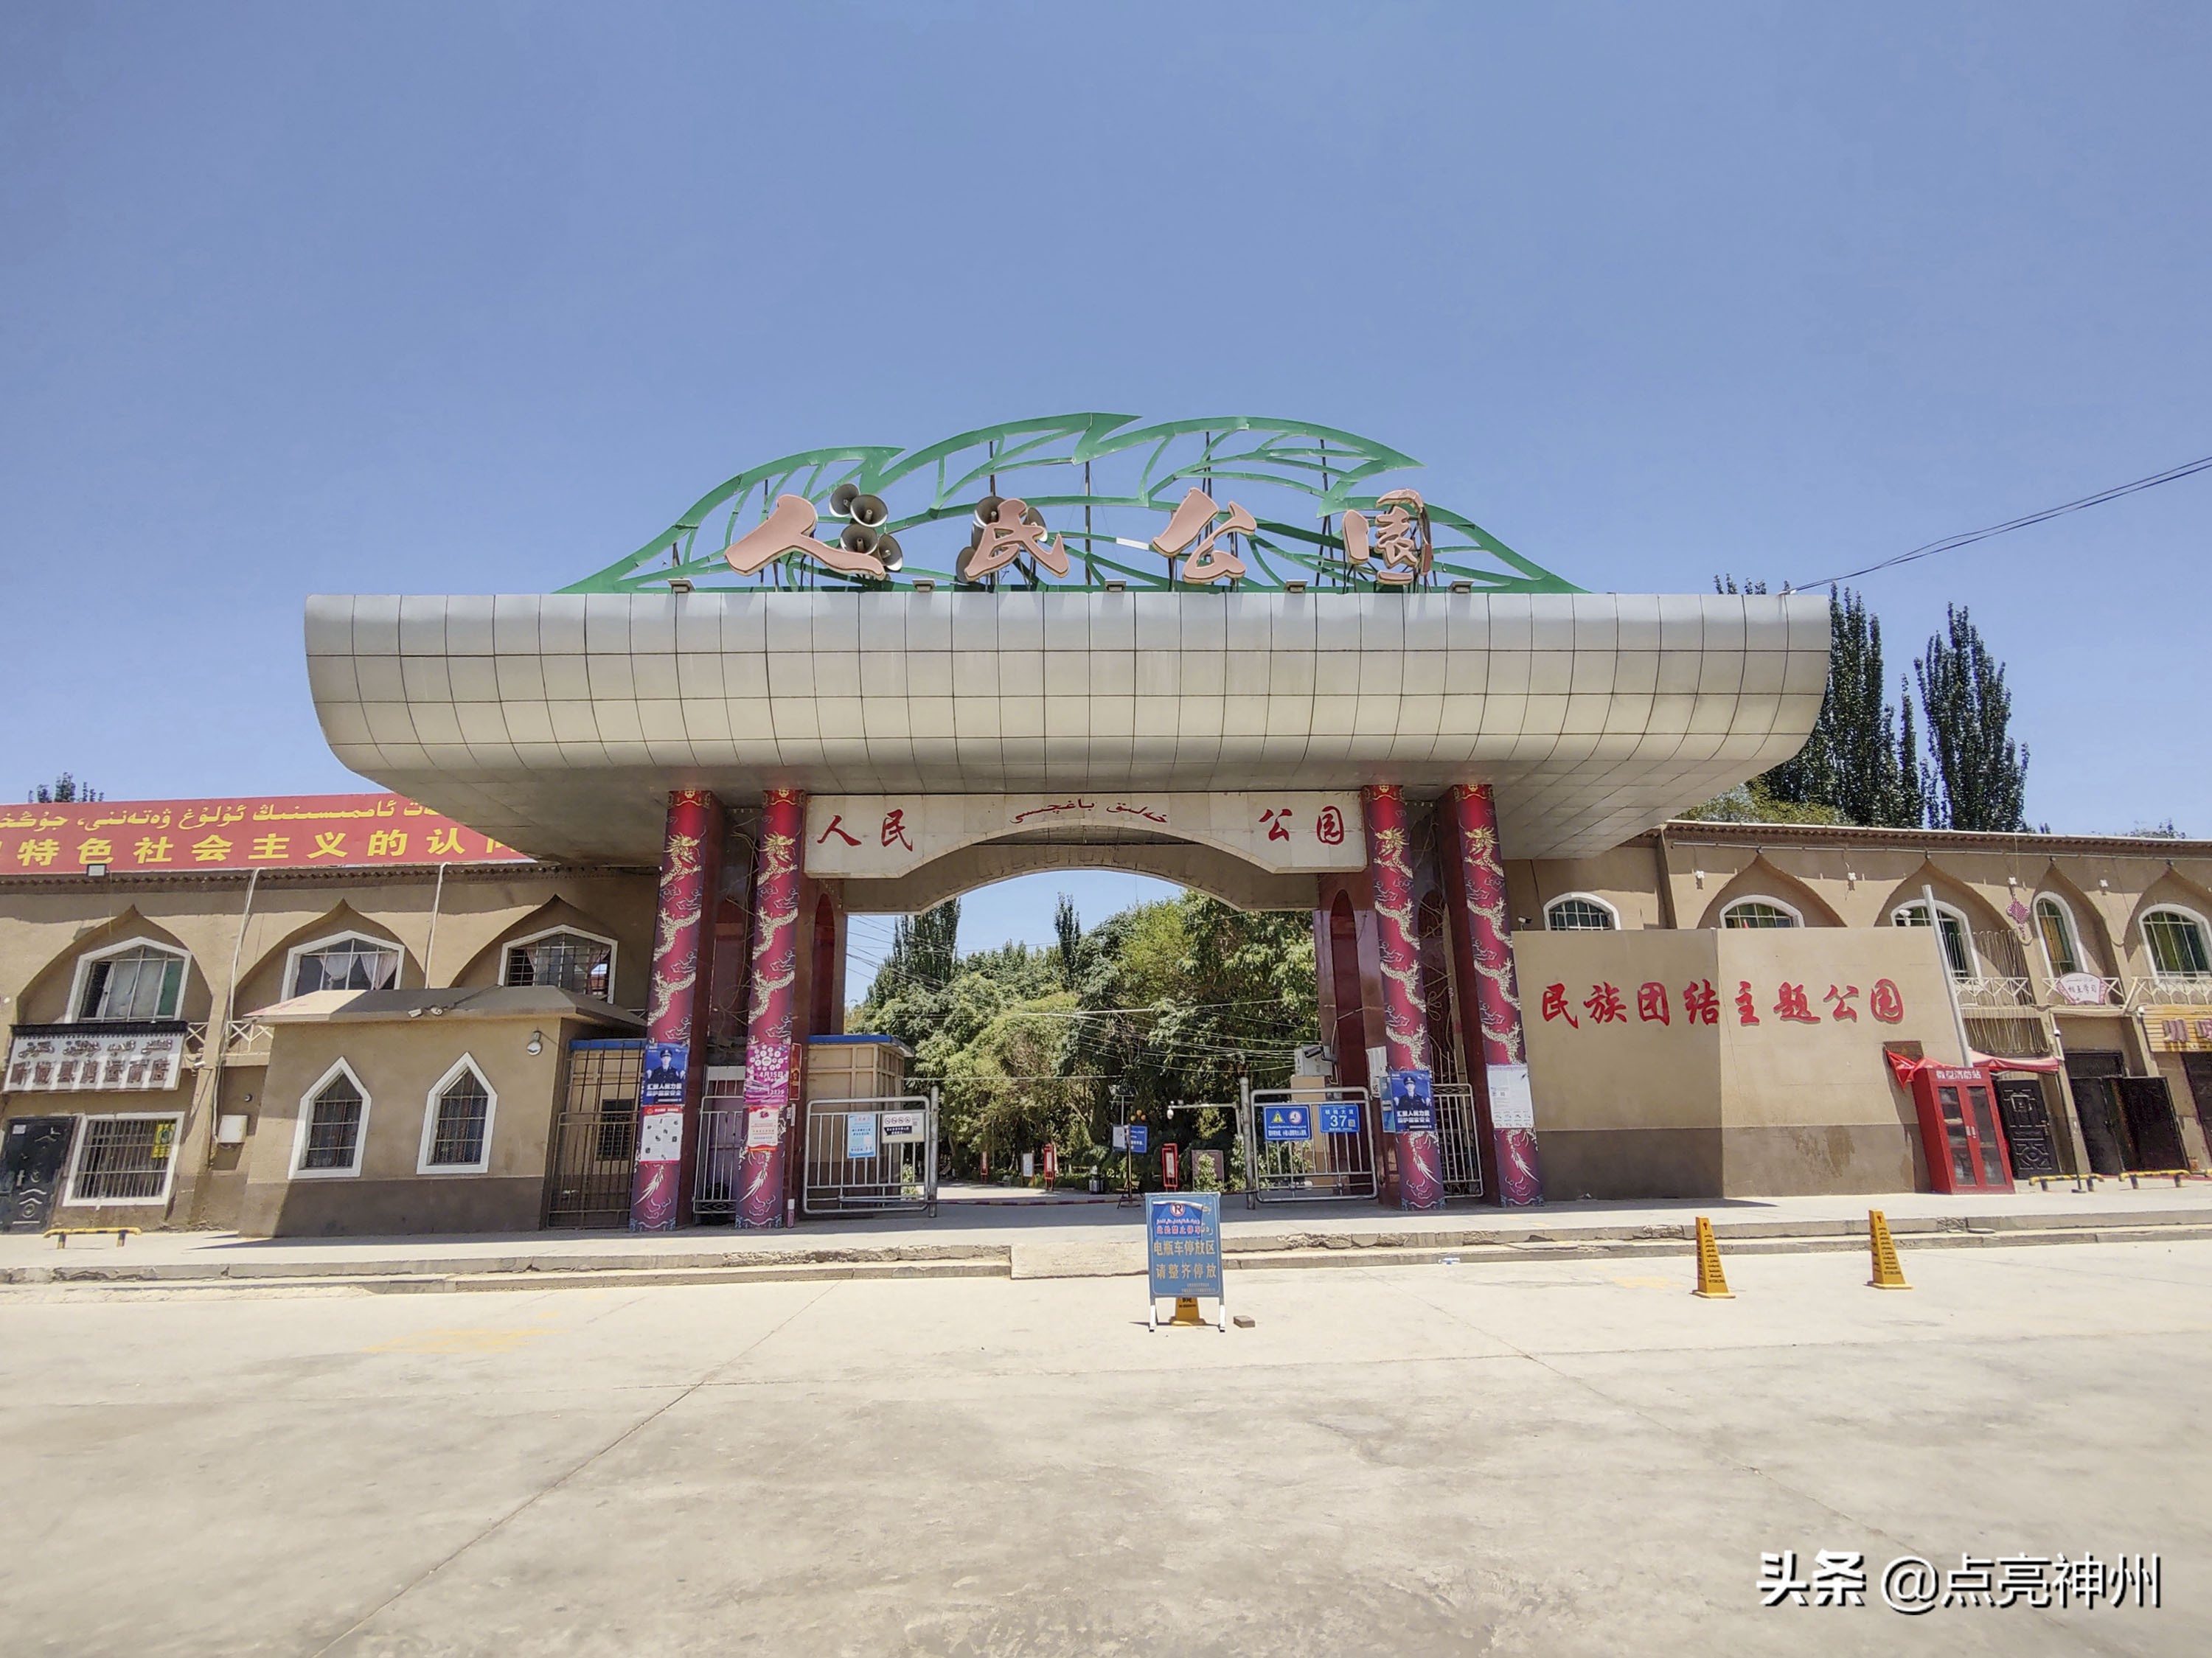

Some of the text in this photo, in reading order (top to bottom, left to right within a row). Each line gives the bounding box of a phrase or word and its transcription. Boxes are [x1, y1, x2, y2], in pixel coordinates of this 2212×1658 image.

[817, 809, 914, 852] 人民
[1259, 807, 1344, 846] 公园
[0, 826, 515, 867] 特色社会主义的认
[1542, 978, 1904, 1029] 民族团结主题公园
[1330, 1115, 1347, 1127] 37
[1153, 1240, 1216, 1257] 电瓶车停放区
[1155, 1262, 1217, 1280] 请整齐停放
